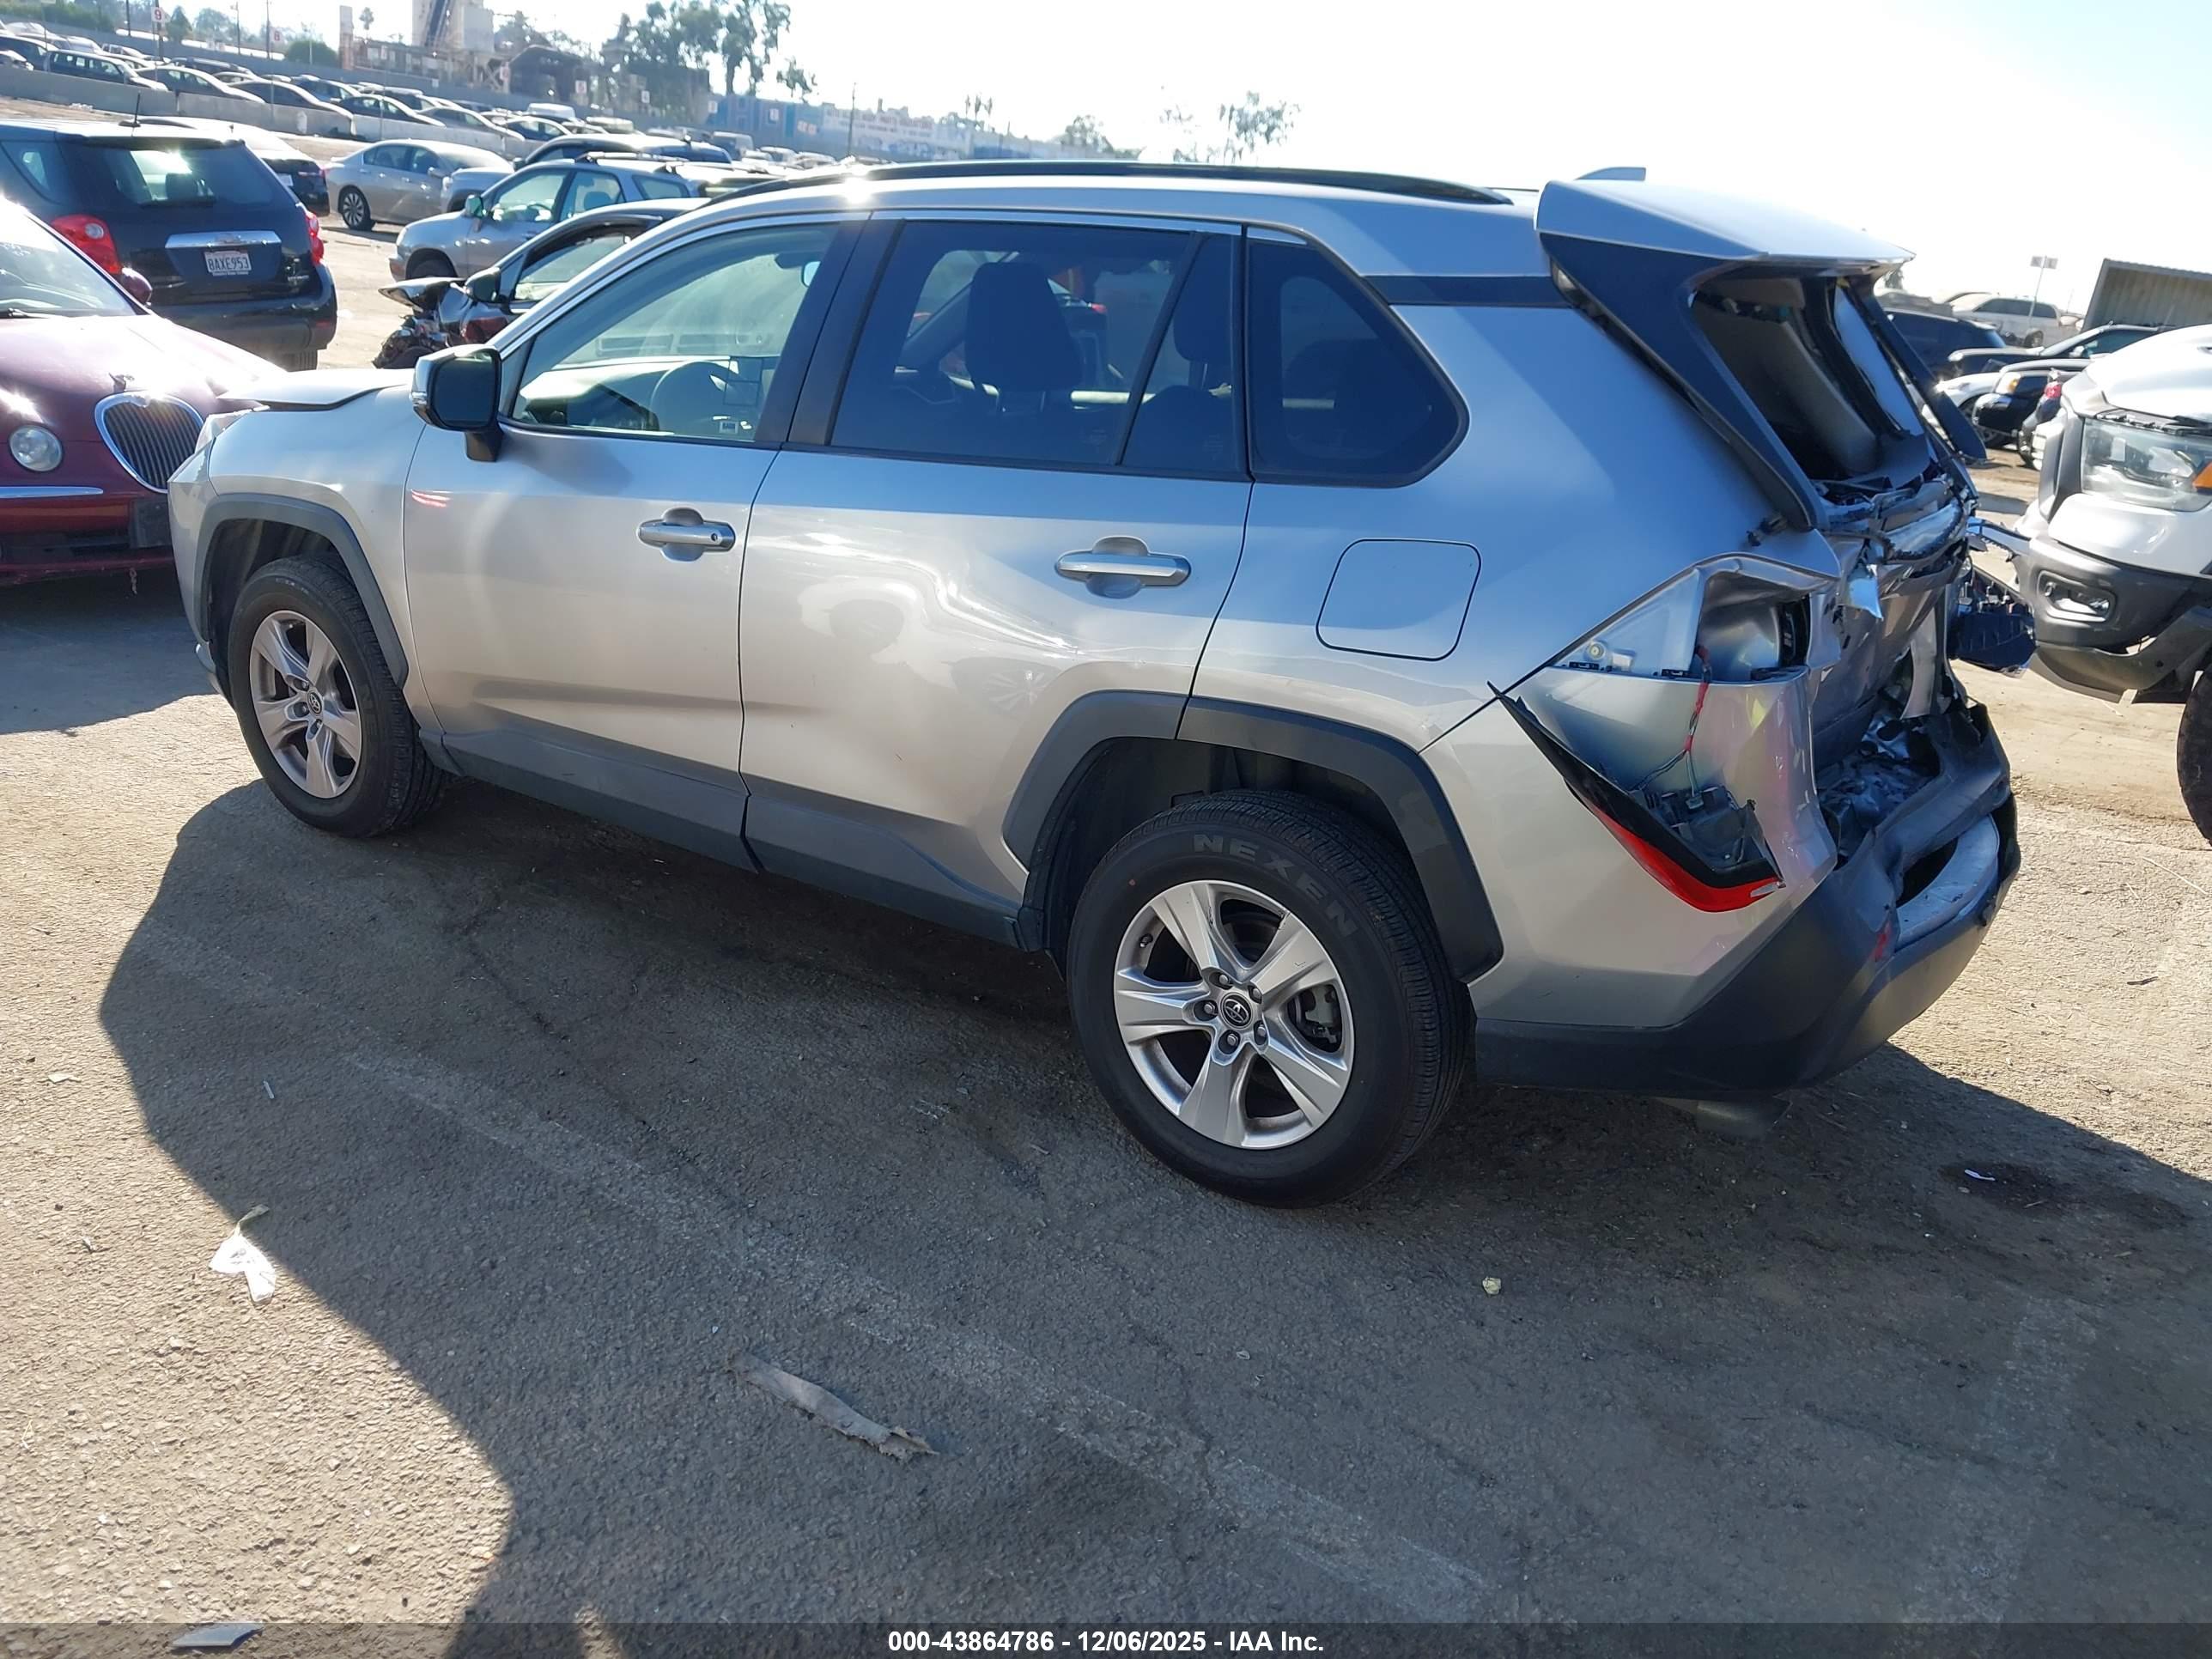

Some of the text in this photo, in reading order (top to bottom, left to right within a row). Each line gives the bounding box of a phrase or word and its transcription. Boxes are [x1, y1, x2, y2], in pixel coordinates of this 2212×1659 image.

[155, 9, 161, 21] 9
[208, 257, 249, 270] 8AXE953
[1194, 834, 1358, 937] NEXEN
